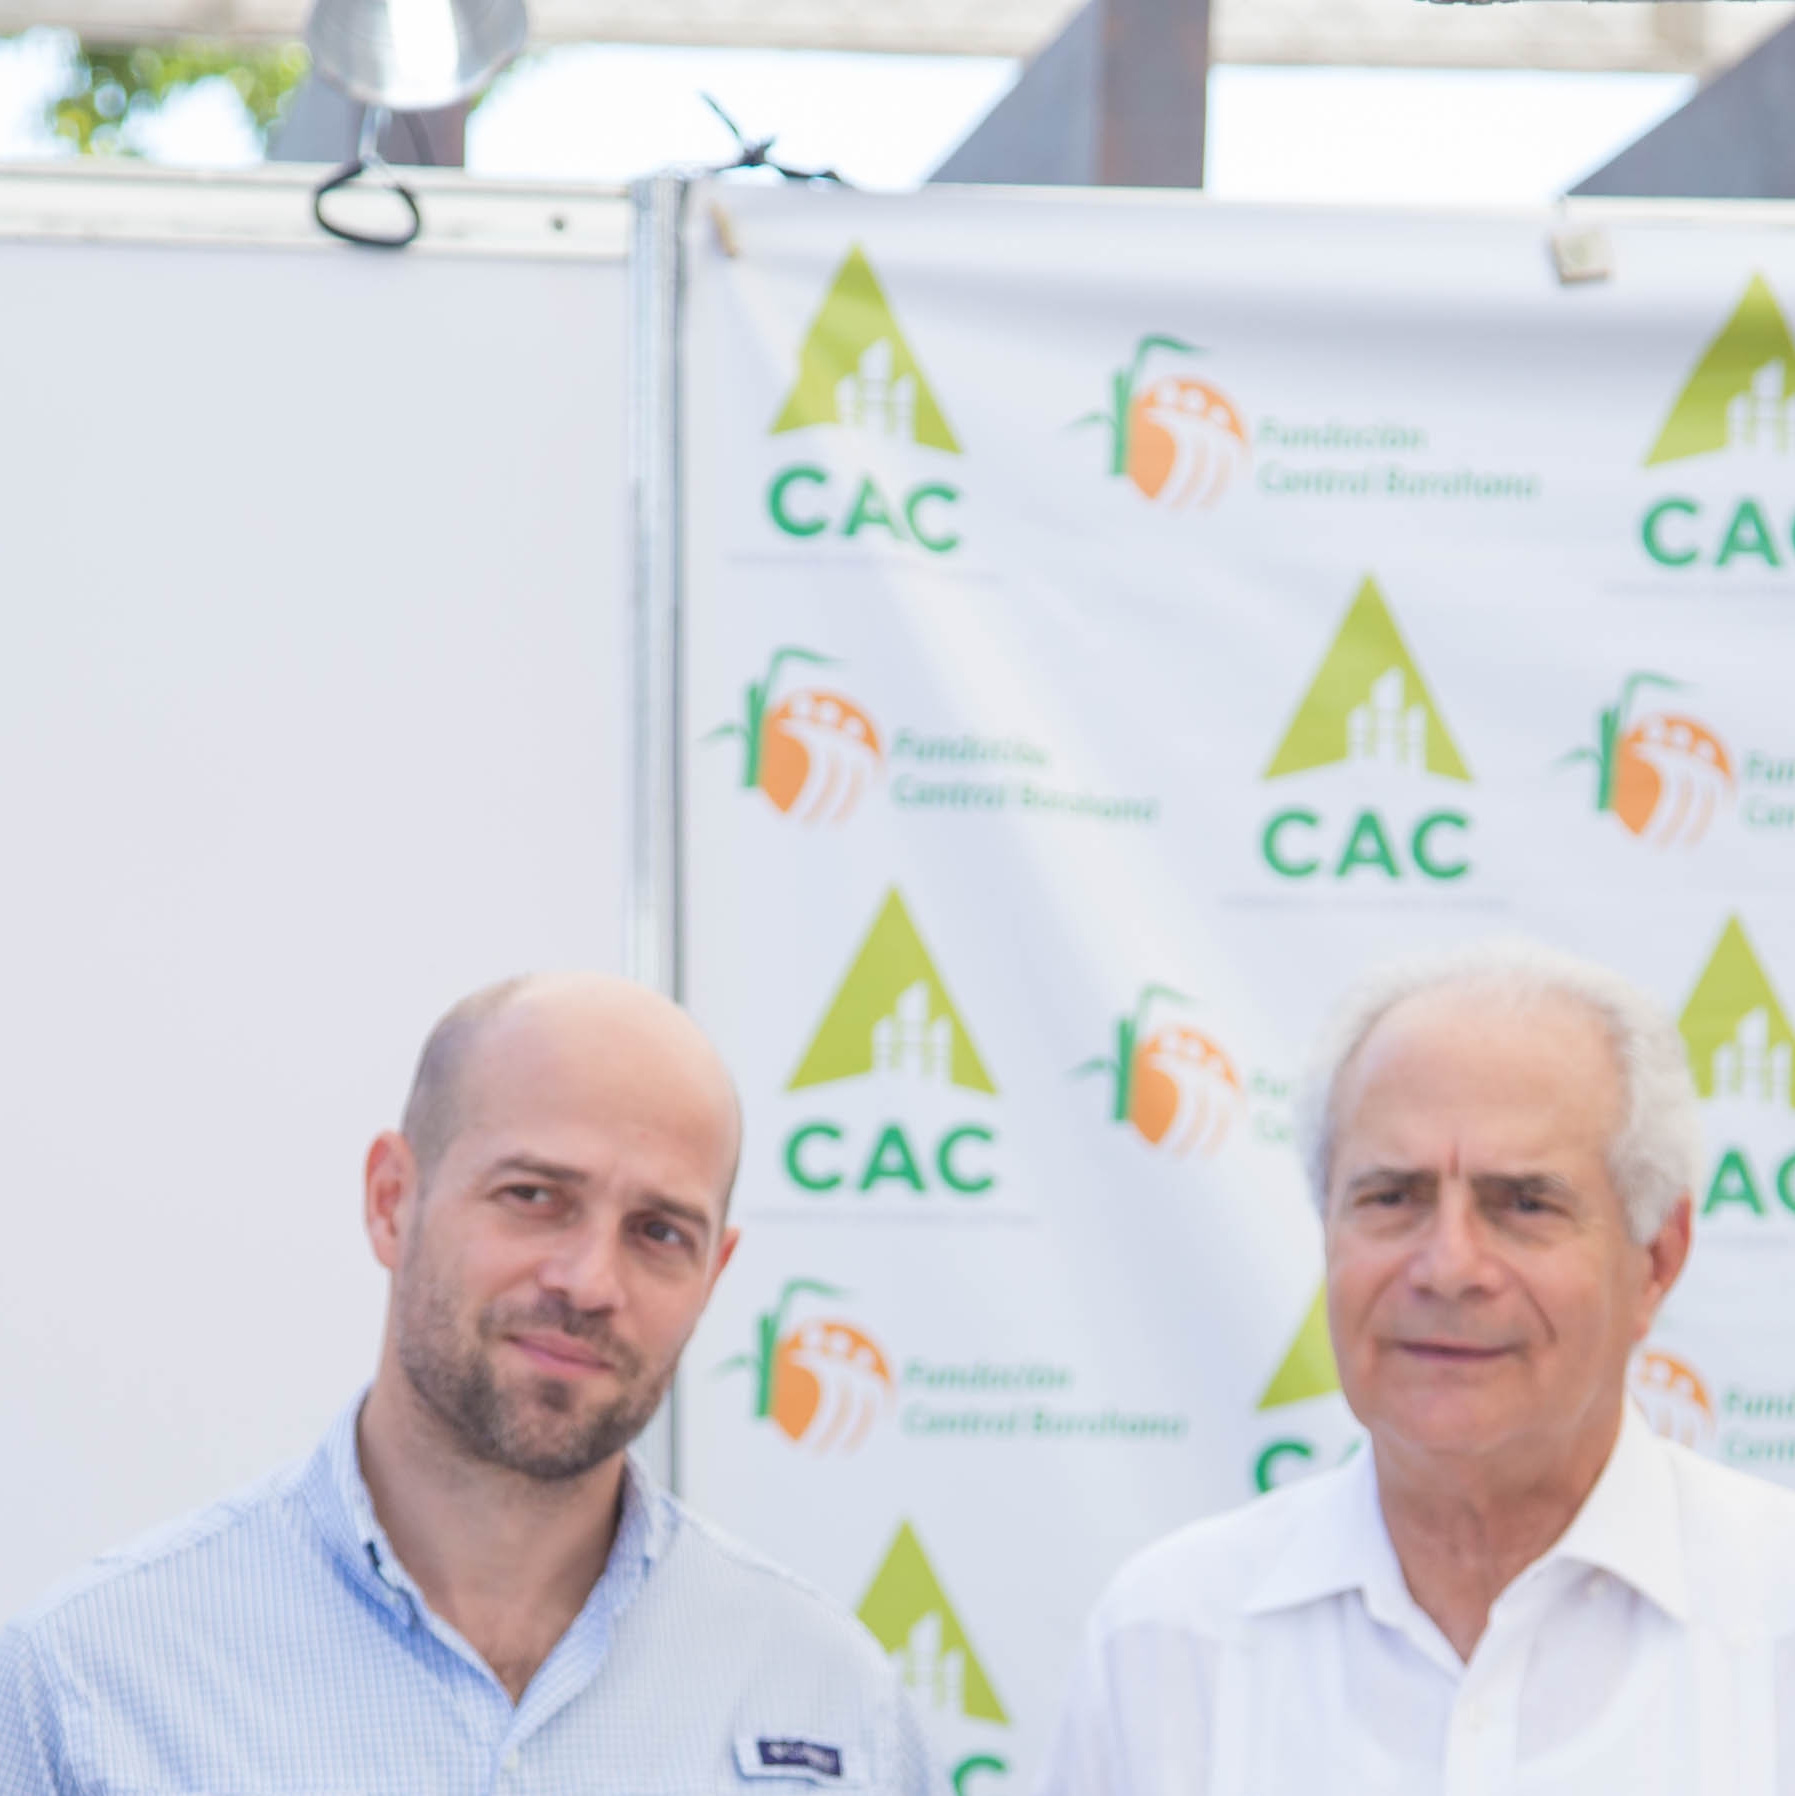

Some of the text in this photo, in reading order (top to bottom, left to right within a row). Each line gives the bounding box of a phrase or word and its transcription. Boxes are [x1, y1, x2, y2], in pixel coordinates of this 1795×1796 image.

[767, 465, 958, 553] CAC
[1261, 809, 1468, 881] CAC
[783, 1122, 993, 1195] CAC
